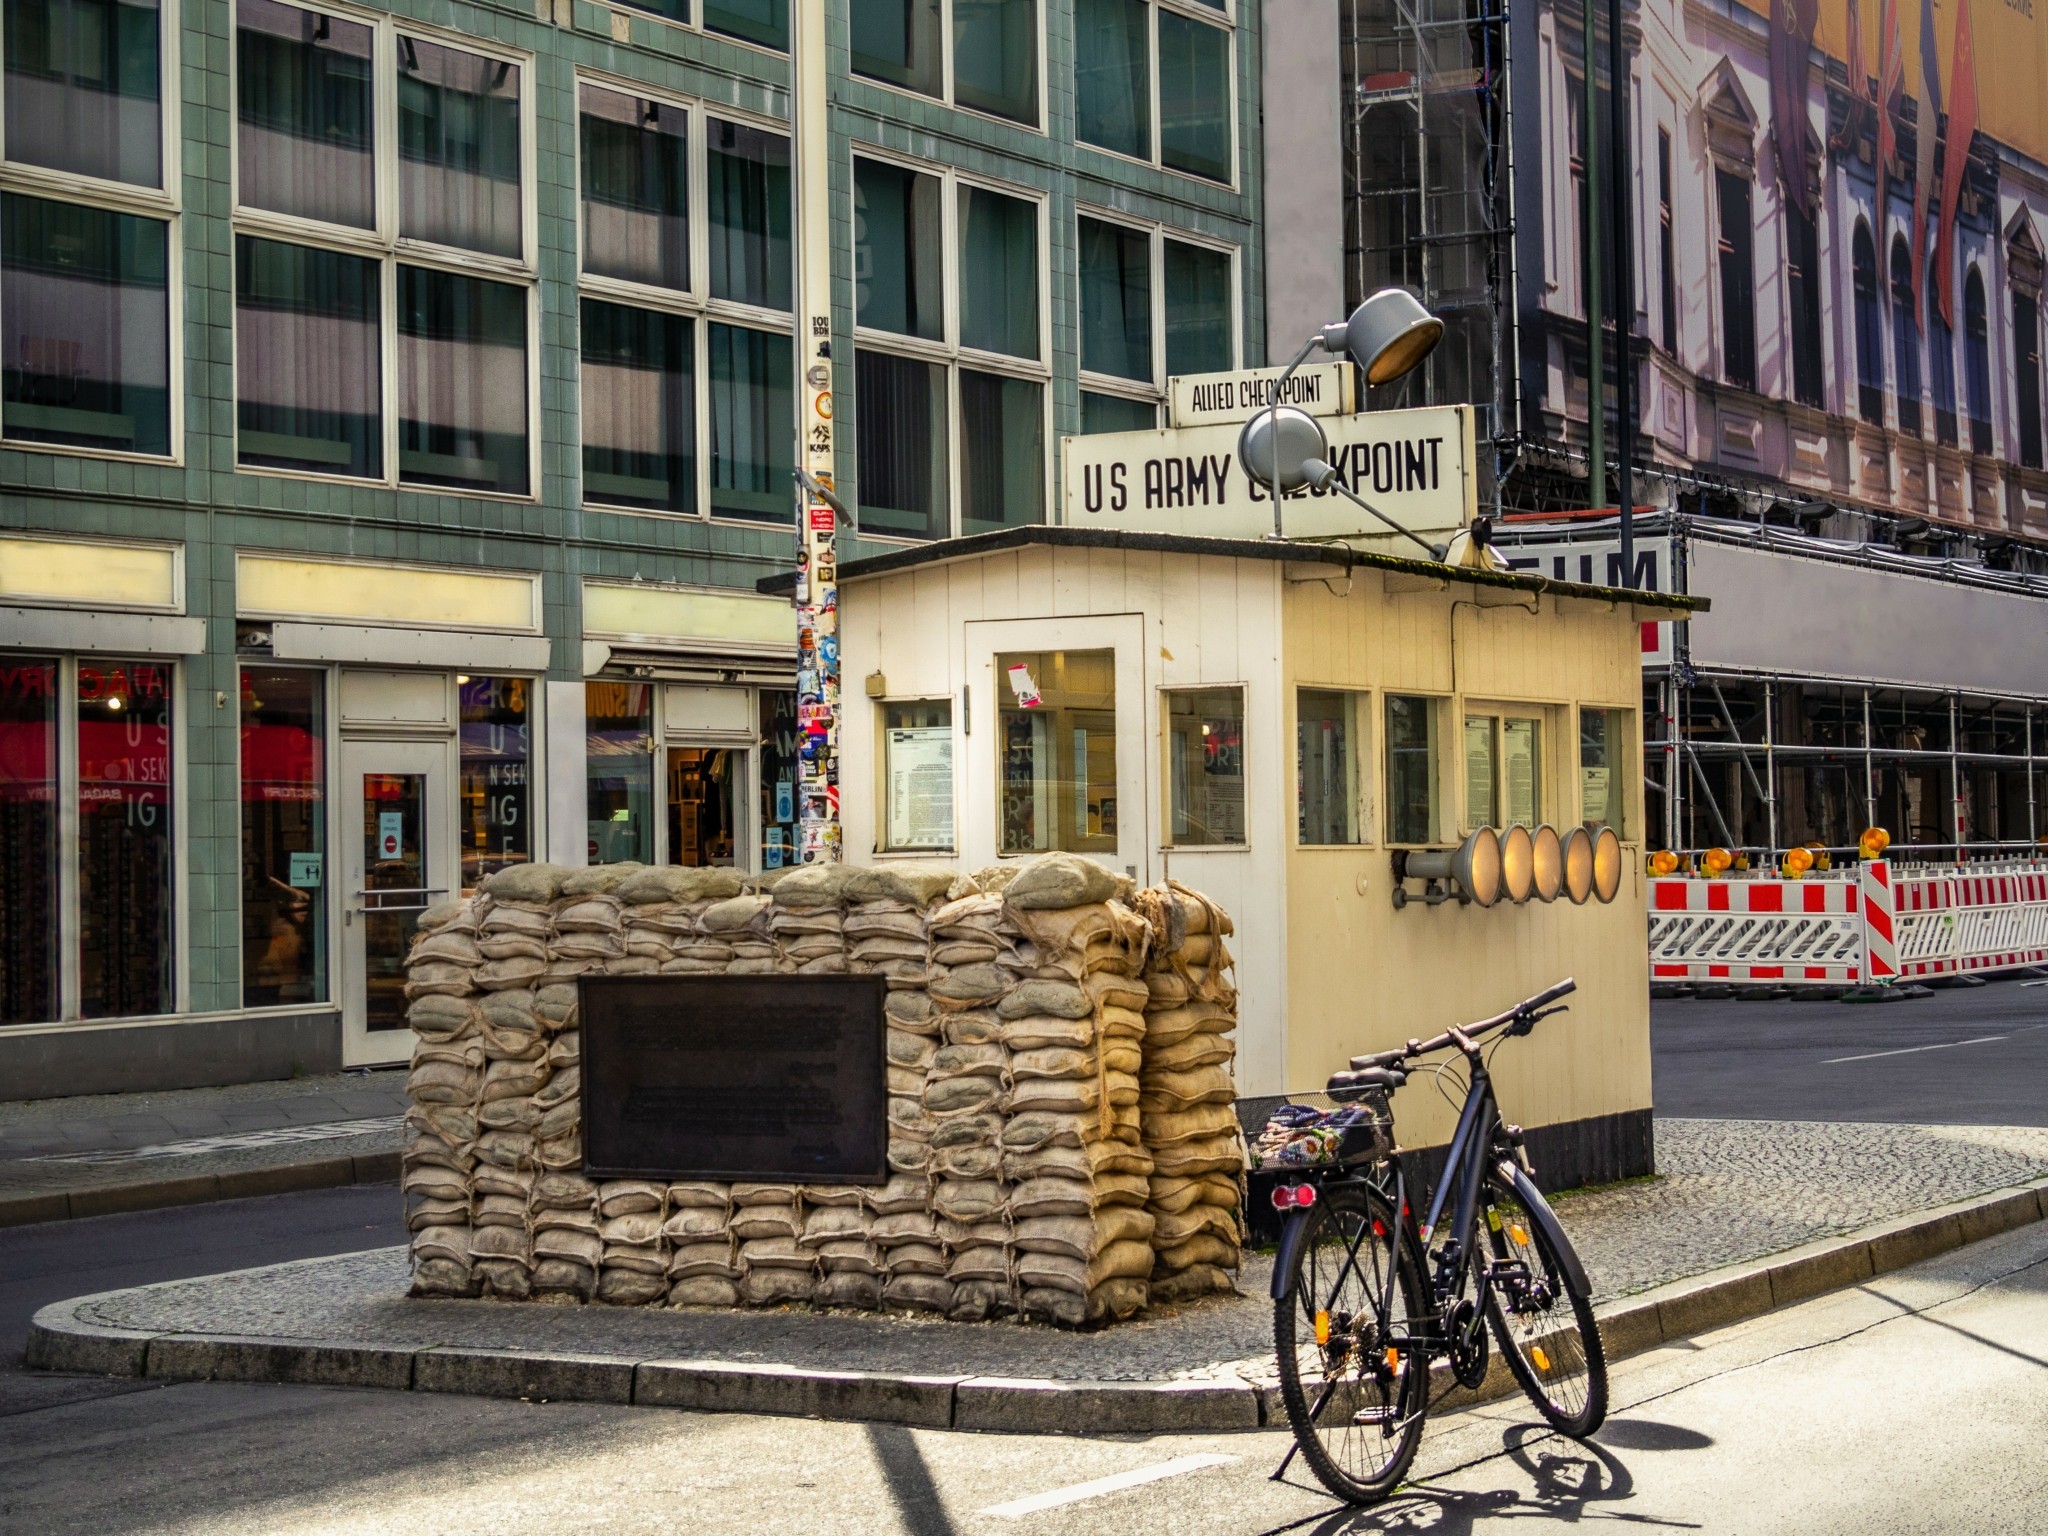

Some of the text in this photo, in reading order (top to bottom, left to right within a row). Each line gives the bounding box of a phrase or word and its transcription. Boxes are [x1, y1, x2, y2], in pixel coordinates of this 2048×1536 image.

[1192, 382, 1234, 412] ALLIED
[1144, 453, 1232, 509] ARMY
[1249, 437, 1443, 503] KPOINT
